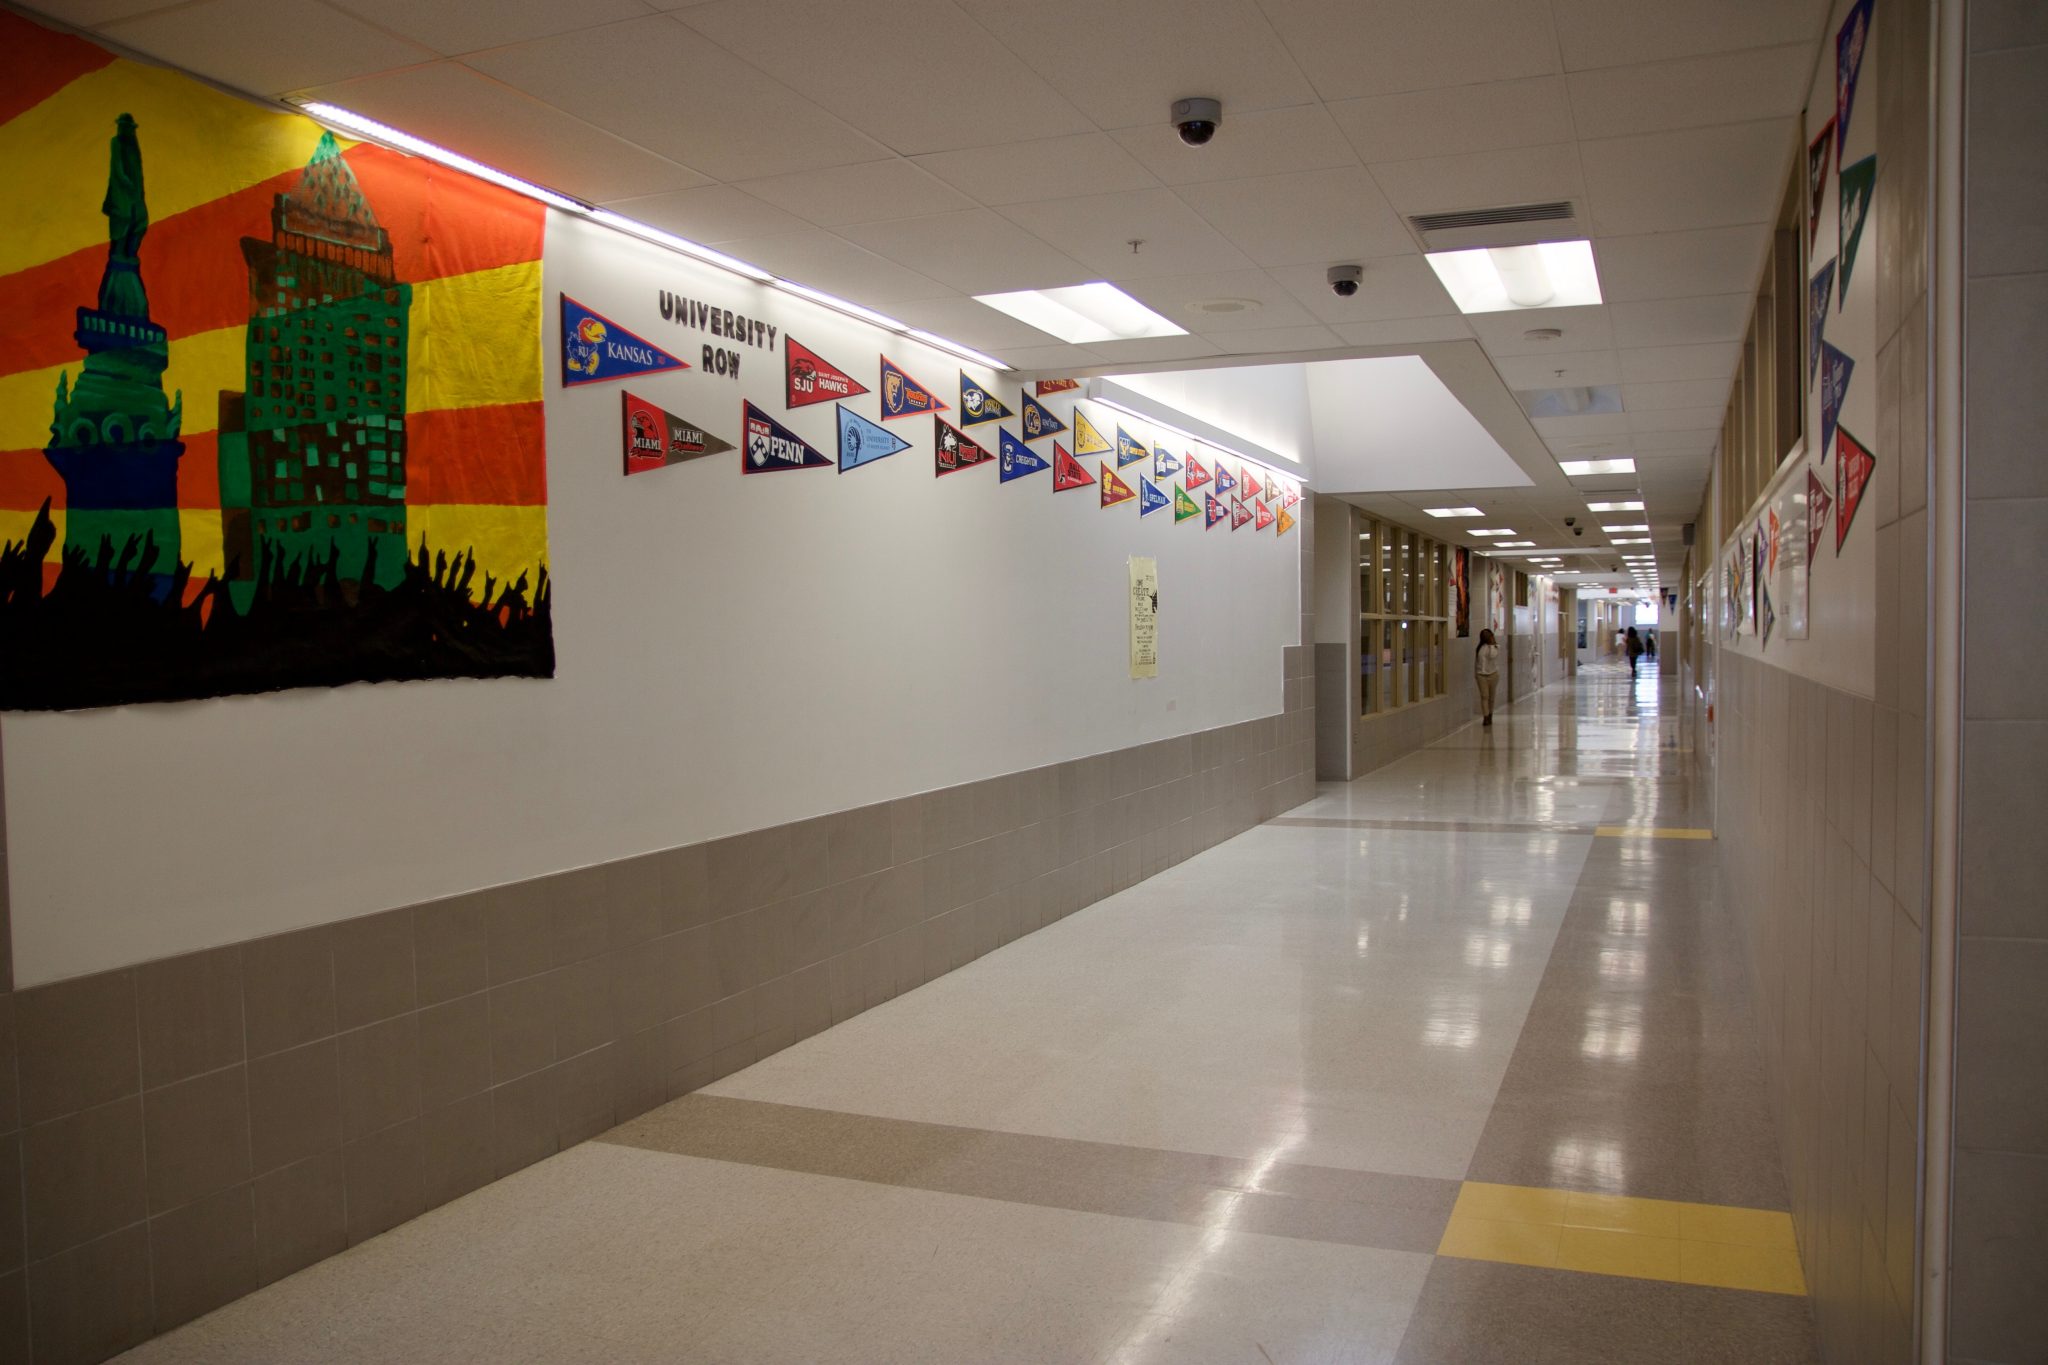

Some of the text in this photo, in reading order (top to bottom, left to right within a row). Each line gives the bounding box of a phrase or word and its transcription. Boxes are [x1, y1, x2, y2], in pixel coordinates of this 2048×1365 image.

[659, 289, 777, 352] UNIVERSITY
[608, 342, 653, 366] KANSAS
[702, 343, 741, 380] ROW
[794, 377, 814, 393] SJU
[818, 378, 848, 394] HAWKS
[633, 438, 661, 450] MIAMI
[674, 430, 704, 444] MIAMI
[771, 436, 805, 464] PENN
[938, 449, 956, 465] NIU
